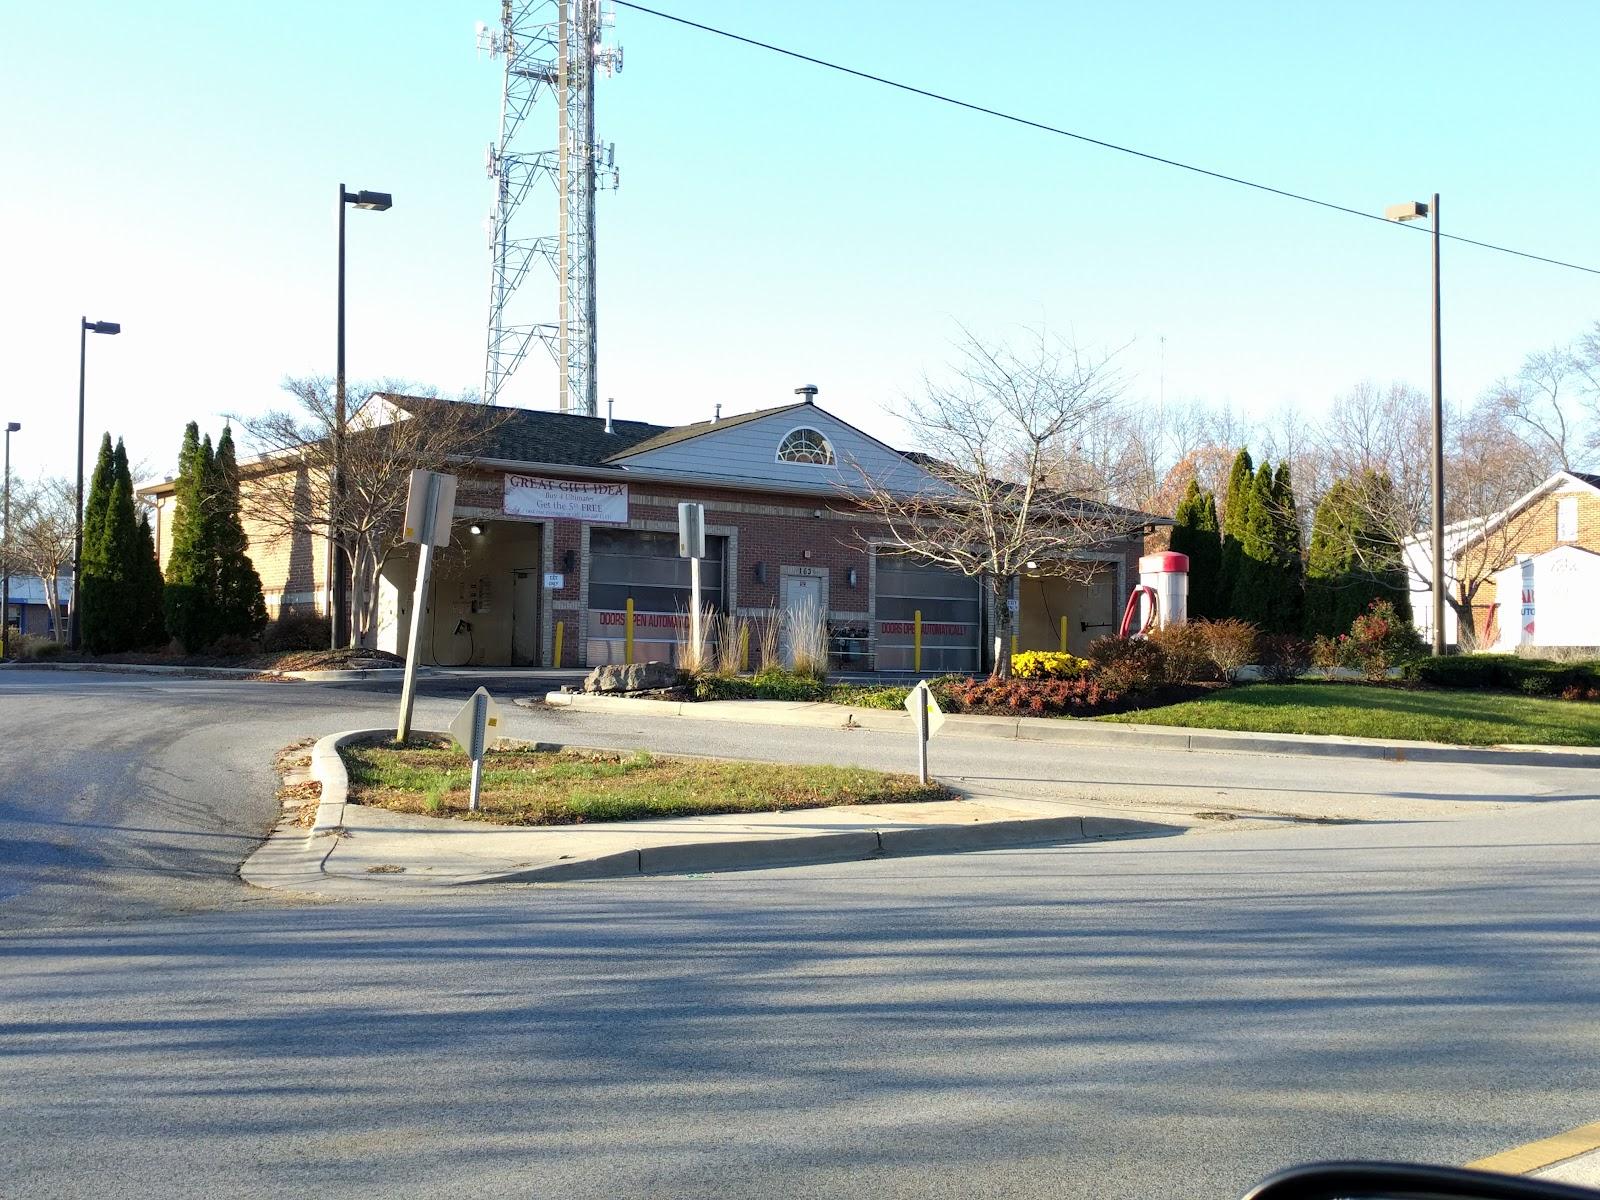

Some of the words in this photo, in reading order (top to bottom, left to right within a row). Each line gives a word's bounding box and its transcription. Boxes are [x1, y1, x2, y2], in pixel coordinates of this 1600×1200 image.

[510, 475, 555, 491] GREAT
[559, 481, 588, 493] GIFT
[593, 483, 626, 496] IDEA
[536, 500, 551, 509] Get
[553, 501, 565, 510] the
[581, 503, 603, 513] FREE
[600, 612, 625, 625] DOORS
[633, 614, 647, 627] PEN
